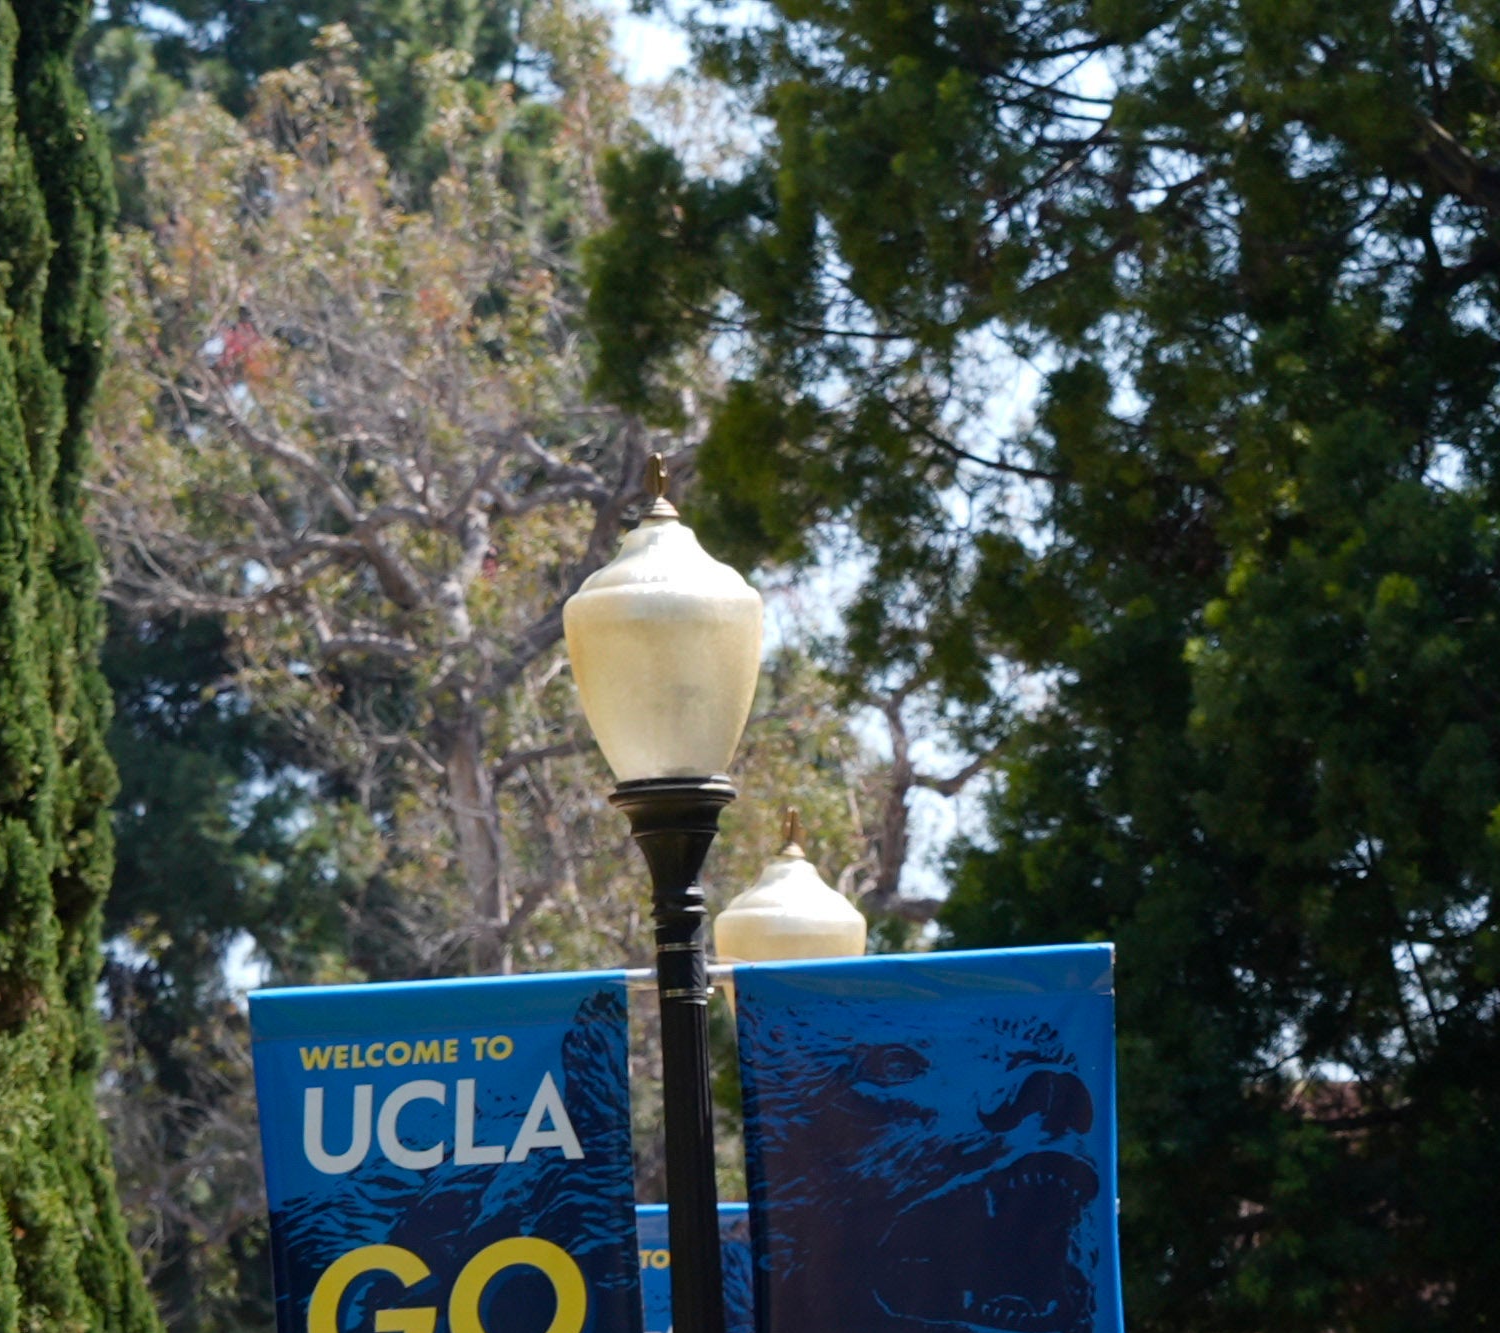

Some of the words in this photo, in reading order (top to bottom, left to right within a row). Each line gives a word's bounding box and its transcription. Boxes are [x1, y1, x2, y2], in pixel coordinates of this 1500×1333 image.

[299, 1038, 459, 1071] WELCOME
[471, 1035, 514, 1061] TO
[303, 1070, 585, 1175] UCLA
